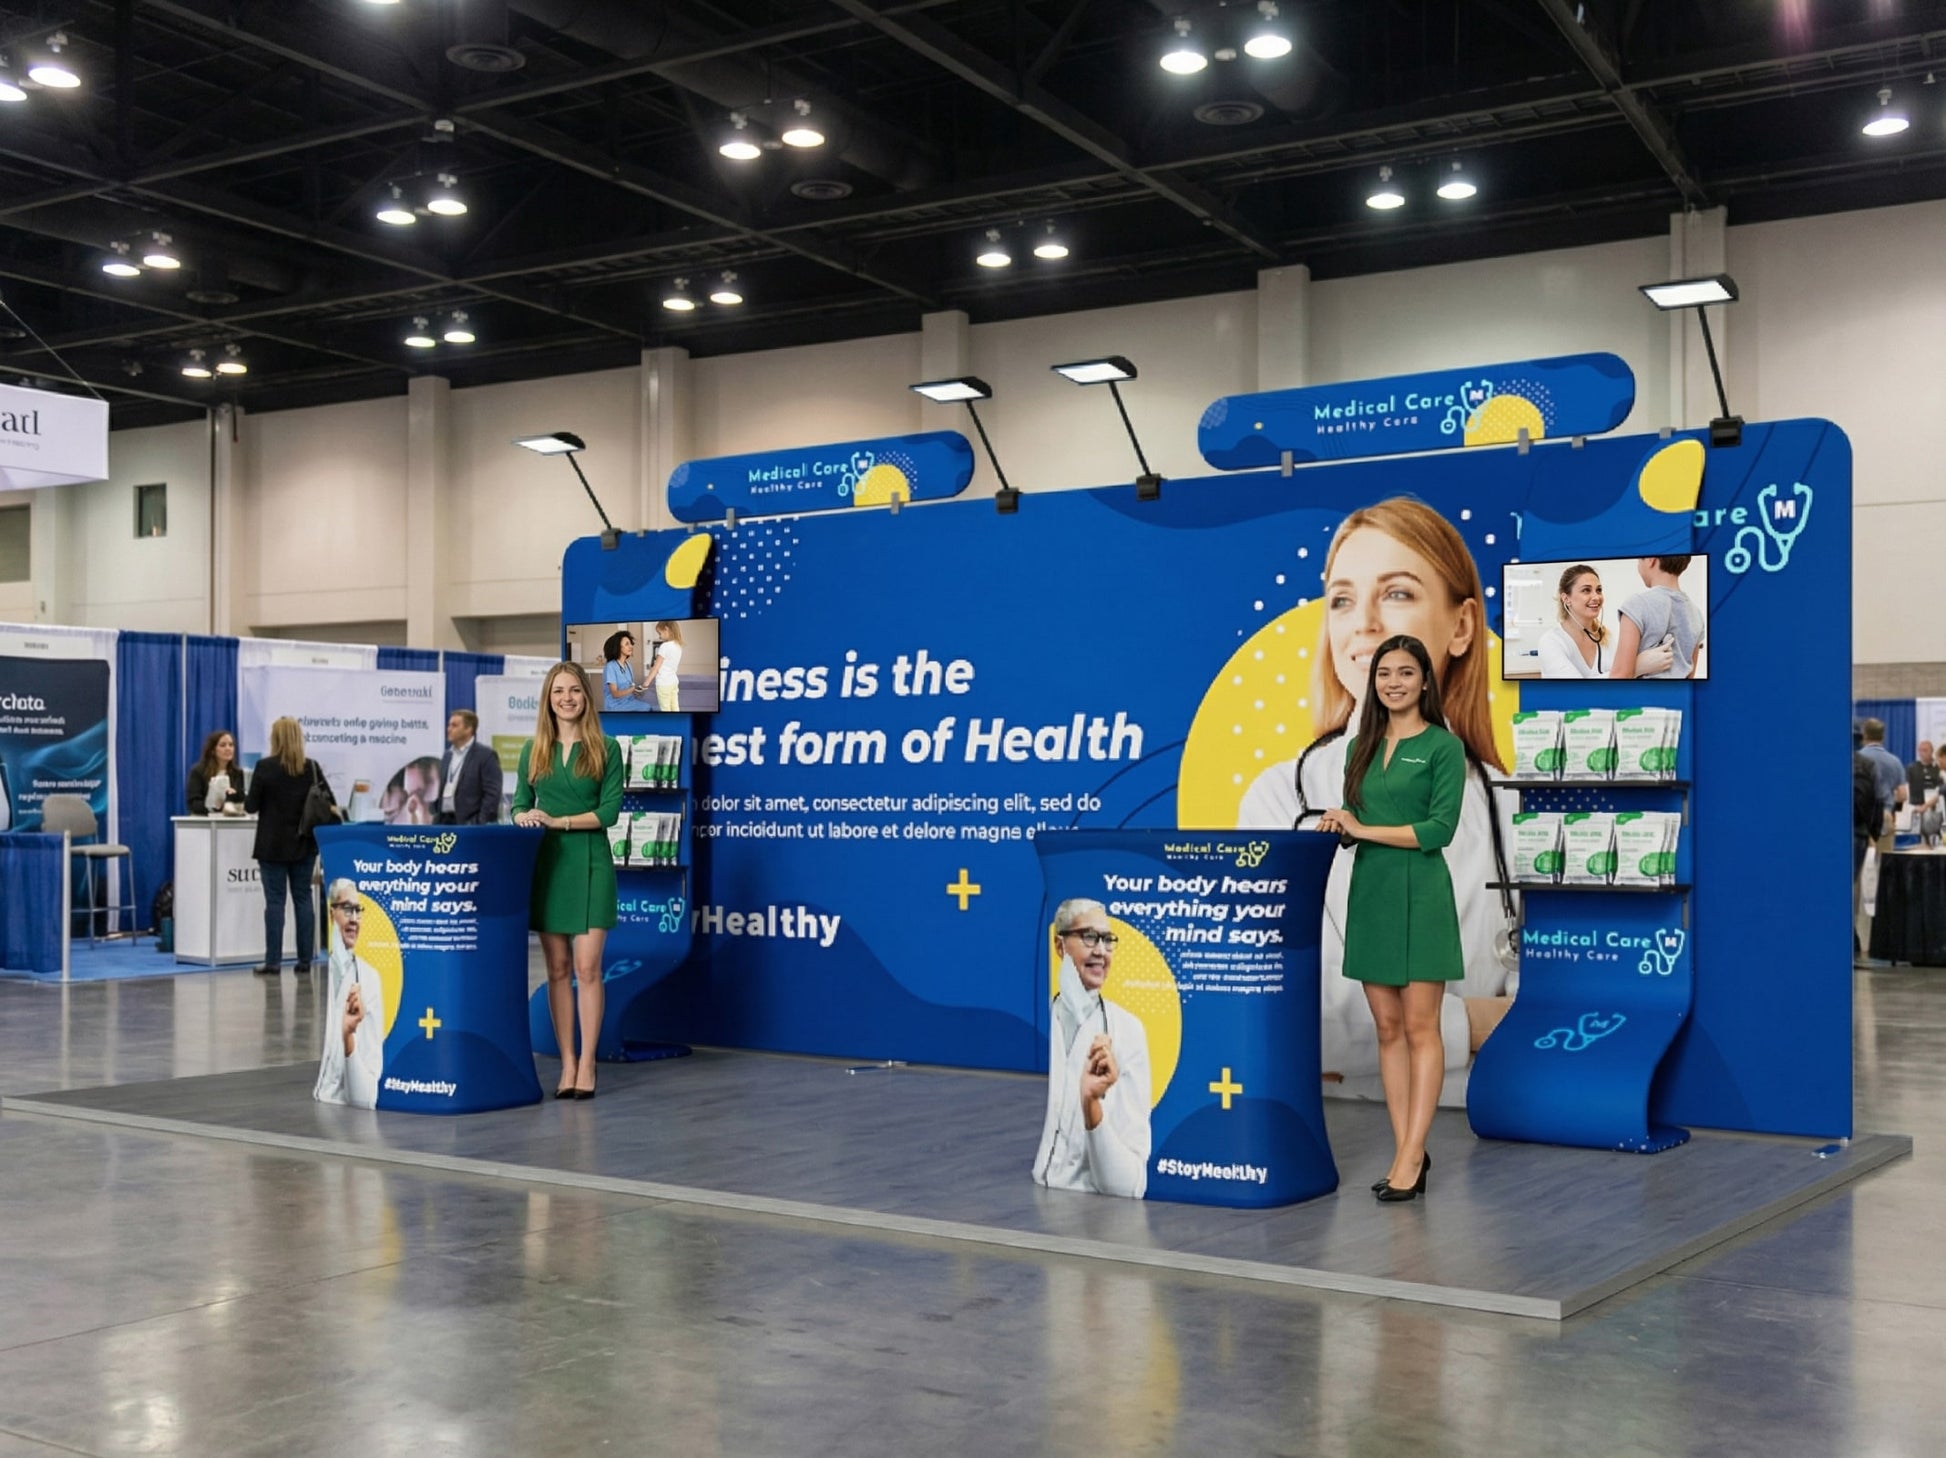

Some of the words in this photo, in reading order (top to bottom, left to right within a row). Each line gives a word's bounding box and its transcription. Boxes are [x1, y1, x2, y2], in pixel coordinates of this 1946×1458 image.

[1314, 394, 1395, 420] Medical
[1405, 393, 1454, 411] Care
[1316, 420, 1376, 435] Healthy
[748, 462, 808, 483] Medical
[812, 460, 849, 476] Care
[840, 649, 880, 698] is
[892, 649, 975, 697] the
[779, 720, 887, 766] form
[901, 716, 956, 763] of
[964, 711, 1143, 763] Health
[701, 794, 740, 812] dolor
[743, 794, 762, 812] sit
[764, 796, 809, 814] amet,
[813, 796, 908, 812] consectetur
[912, 793, 999, 815] adipiscing
[1003, 793, 1037, 814] elit,
[1040, 793, 1073, 812] sed
[1077, 793, 1101, 812] do
[807, 823, 825, 838] ut
[828, 821, 879, 838] labore
[881, 822, 899, 838] et
[353, 860, 383, 874] Your
[386, 860, 422, 876] body
[359, 878, 431, 895] everything
[433, 881, 480, 896] your
[1103, 874, 1153, 892] Your
[1157, 875, 1218, 896] body
[1220, 876, 1289, 894] hears
[390, 897, 428, 912] mind
[431, 900, 478, 915] says.
[1109, 899, 1229, 921] everything
[1232, 903, 1286, 923] your
[1164, 923, 1224, 943] mind
[1227, 929, 1284, 947] says.
[1523, 929, 1597, 946] Medical
[1606, 932, 1652, 949] Care
[1525, 948, 1579, 961] Healthy
[1586, 949, 1619, 961] Care
